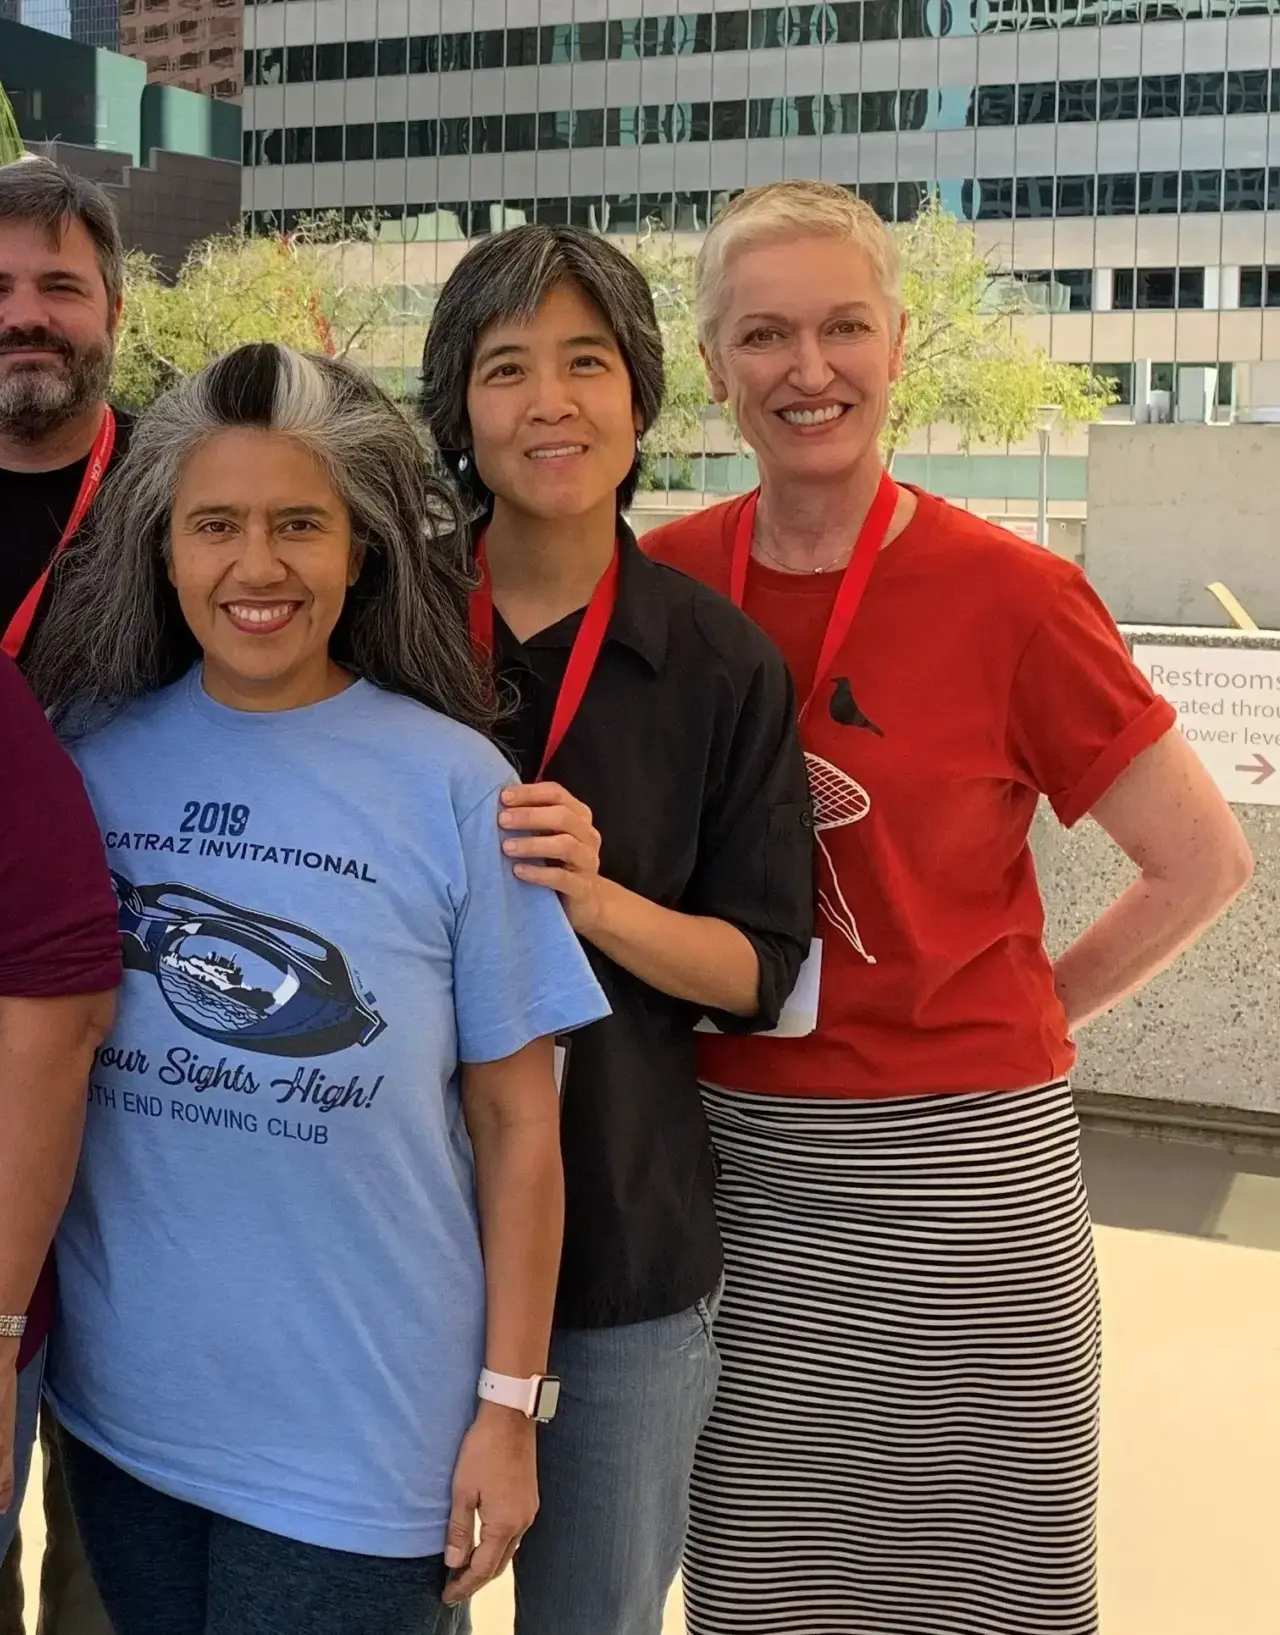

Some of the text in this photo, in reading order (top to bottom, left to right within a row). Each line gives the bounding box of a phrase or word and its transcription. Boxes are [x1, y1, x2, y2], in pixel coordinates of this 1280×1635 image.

[1170, 697, 1224, 716] ated
[179, 800, 250, 837] 2019
[104, 831, 377, 884] CATRAZ INVITATIONAL
[92, 1046, 385, 1113] our Sights High!
[123, 1091, 163, 1117] END
[171, 1100, 258, 1133] ROWING
[267, 1118, 329, 1145] CLUB
